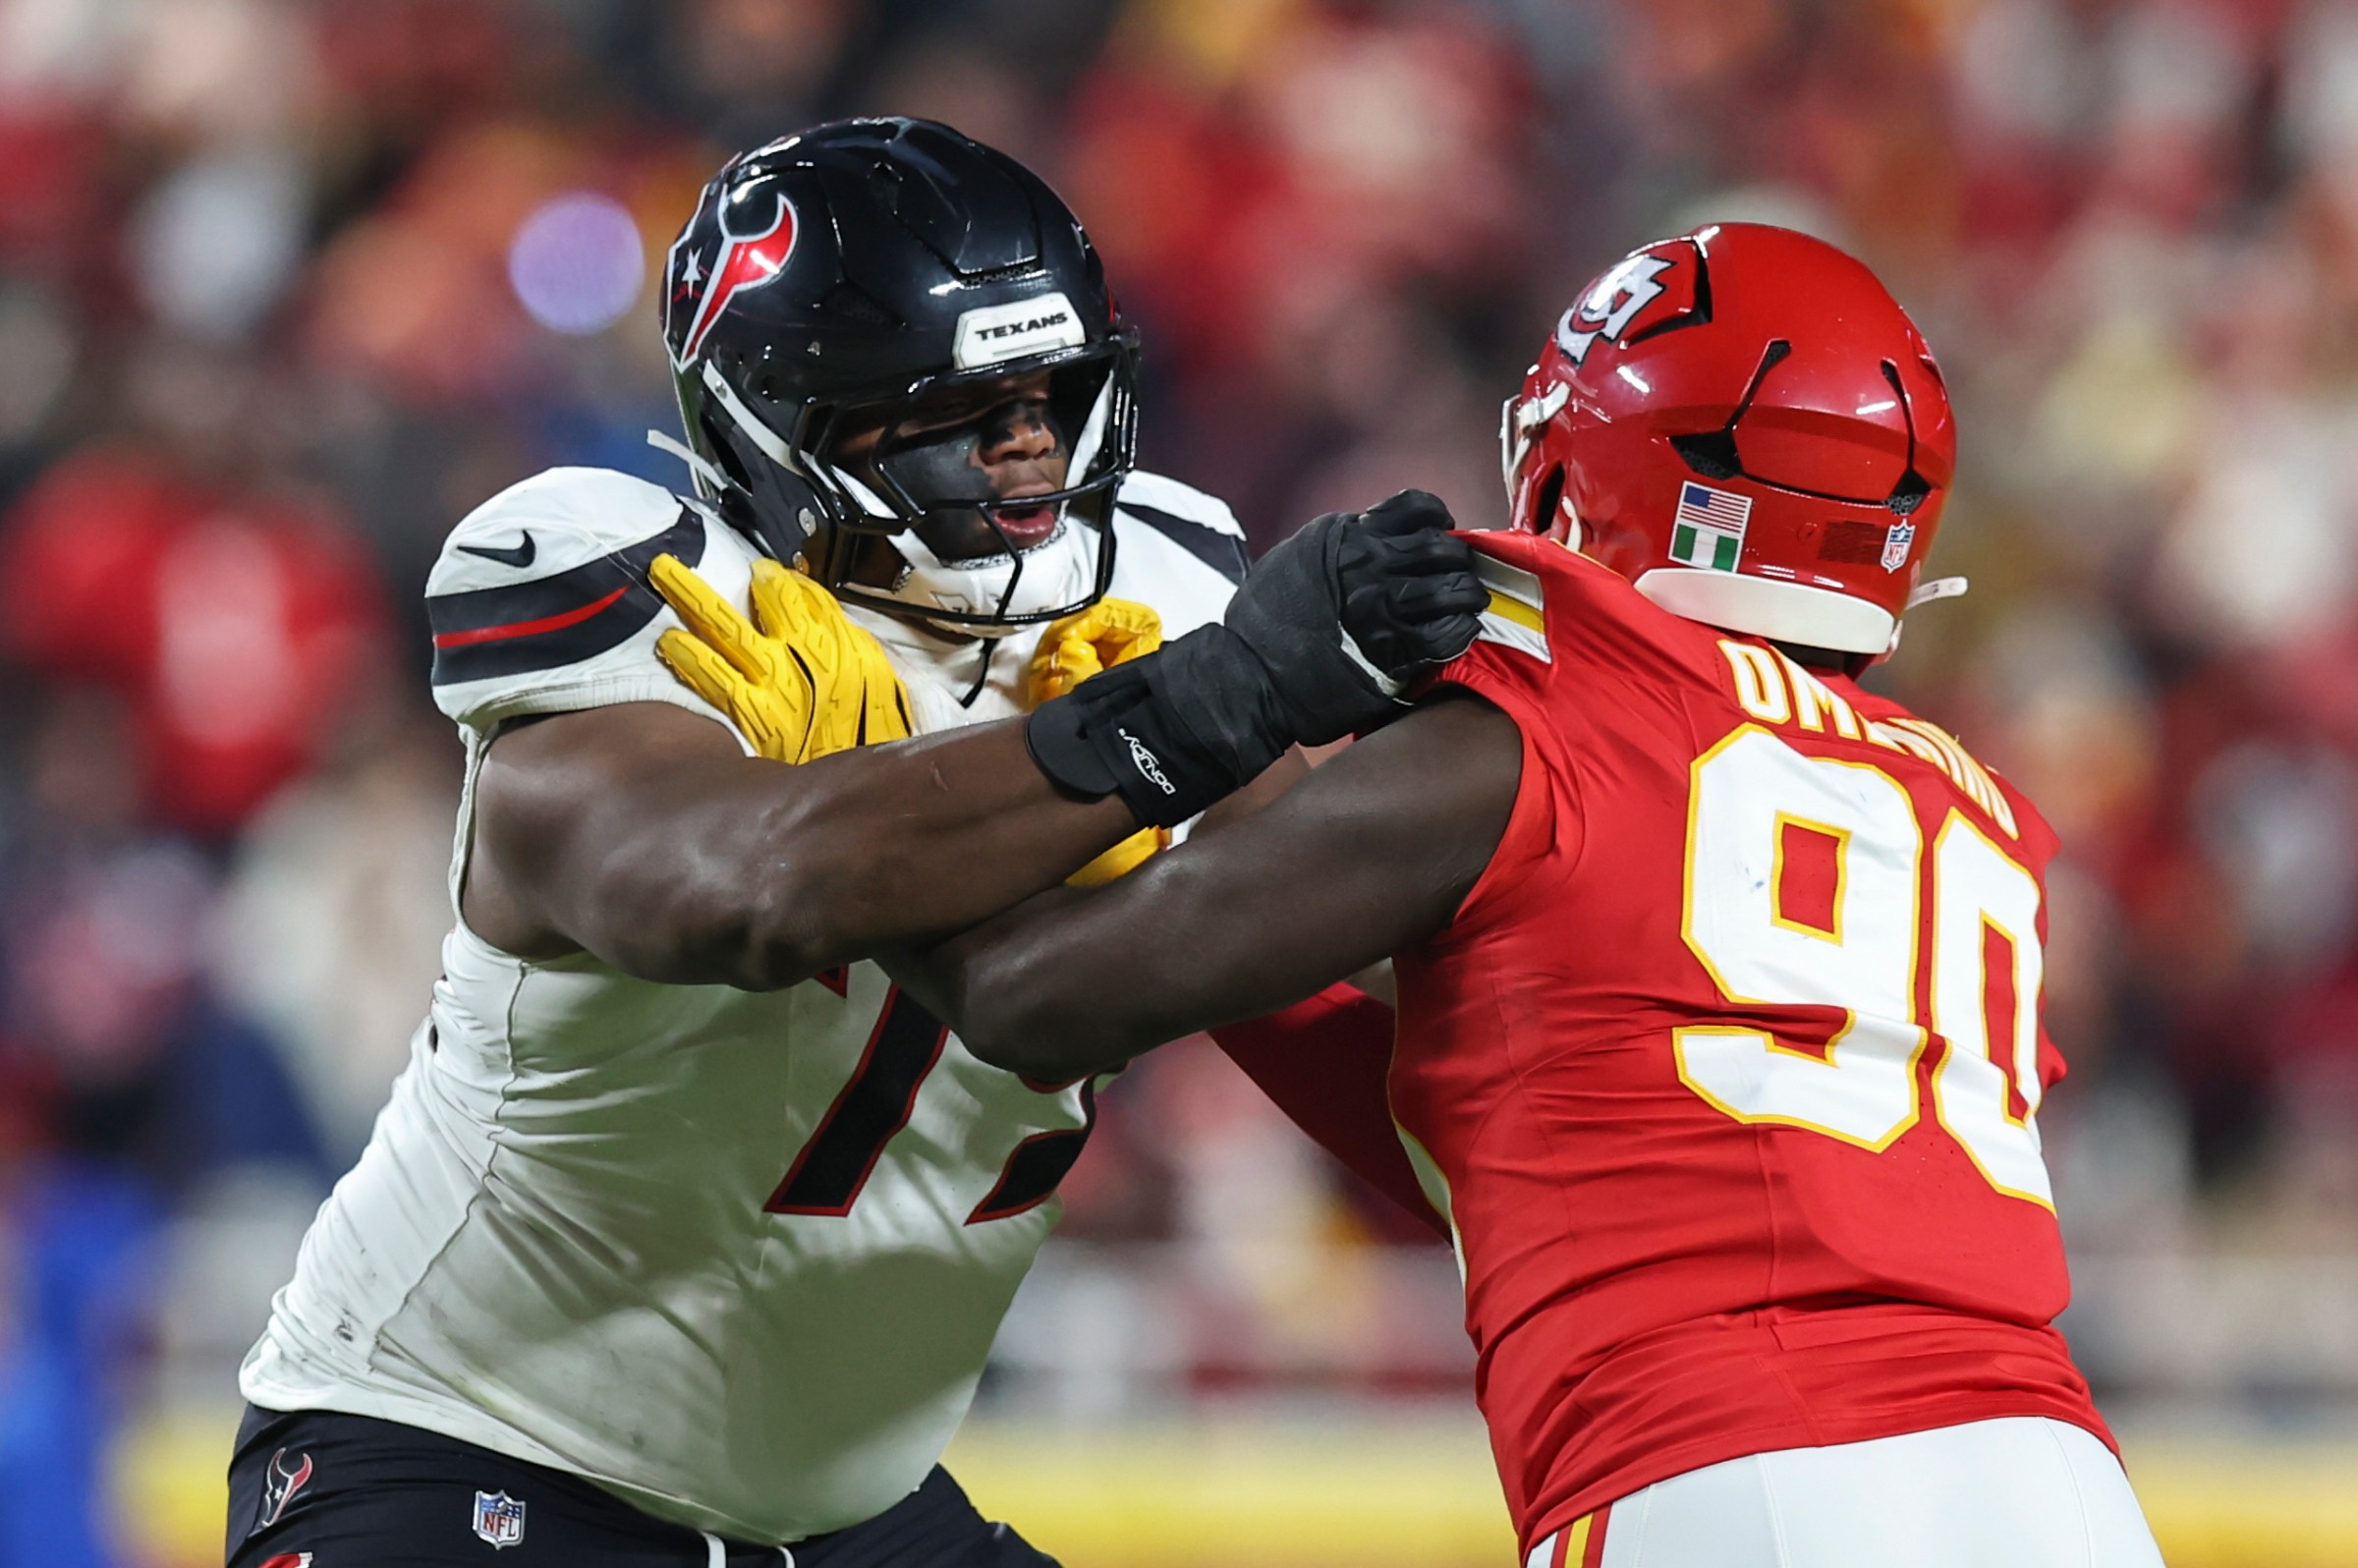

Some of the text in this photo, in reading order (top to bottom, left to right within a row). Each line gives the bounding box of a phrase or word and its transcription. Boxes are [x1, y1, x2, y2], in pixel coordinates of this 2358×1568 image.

[976, 312, 1068, 341] TEXANS
[1885, 543, 1906, 564] NFL
[1672, 722, 2058, 1219] 90
[483, 1512, 517, 1538] NFL
